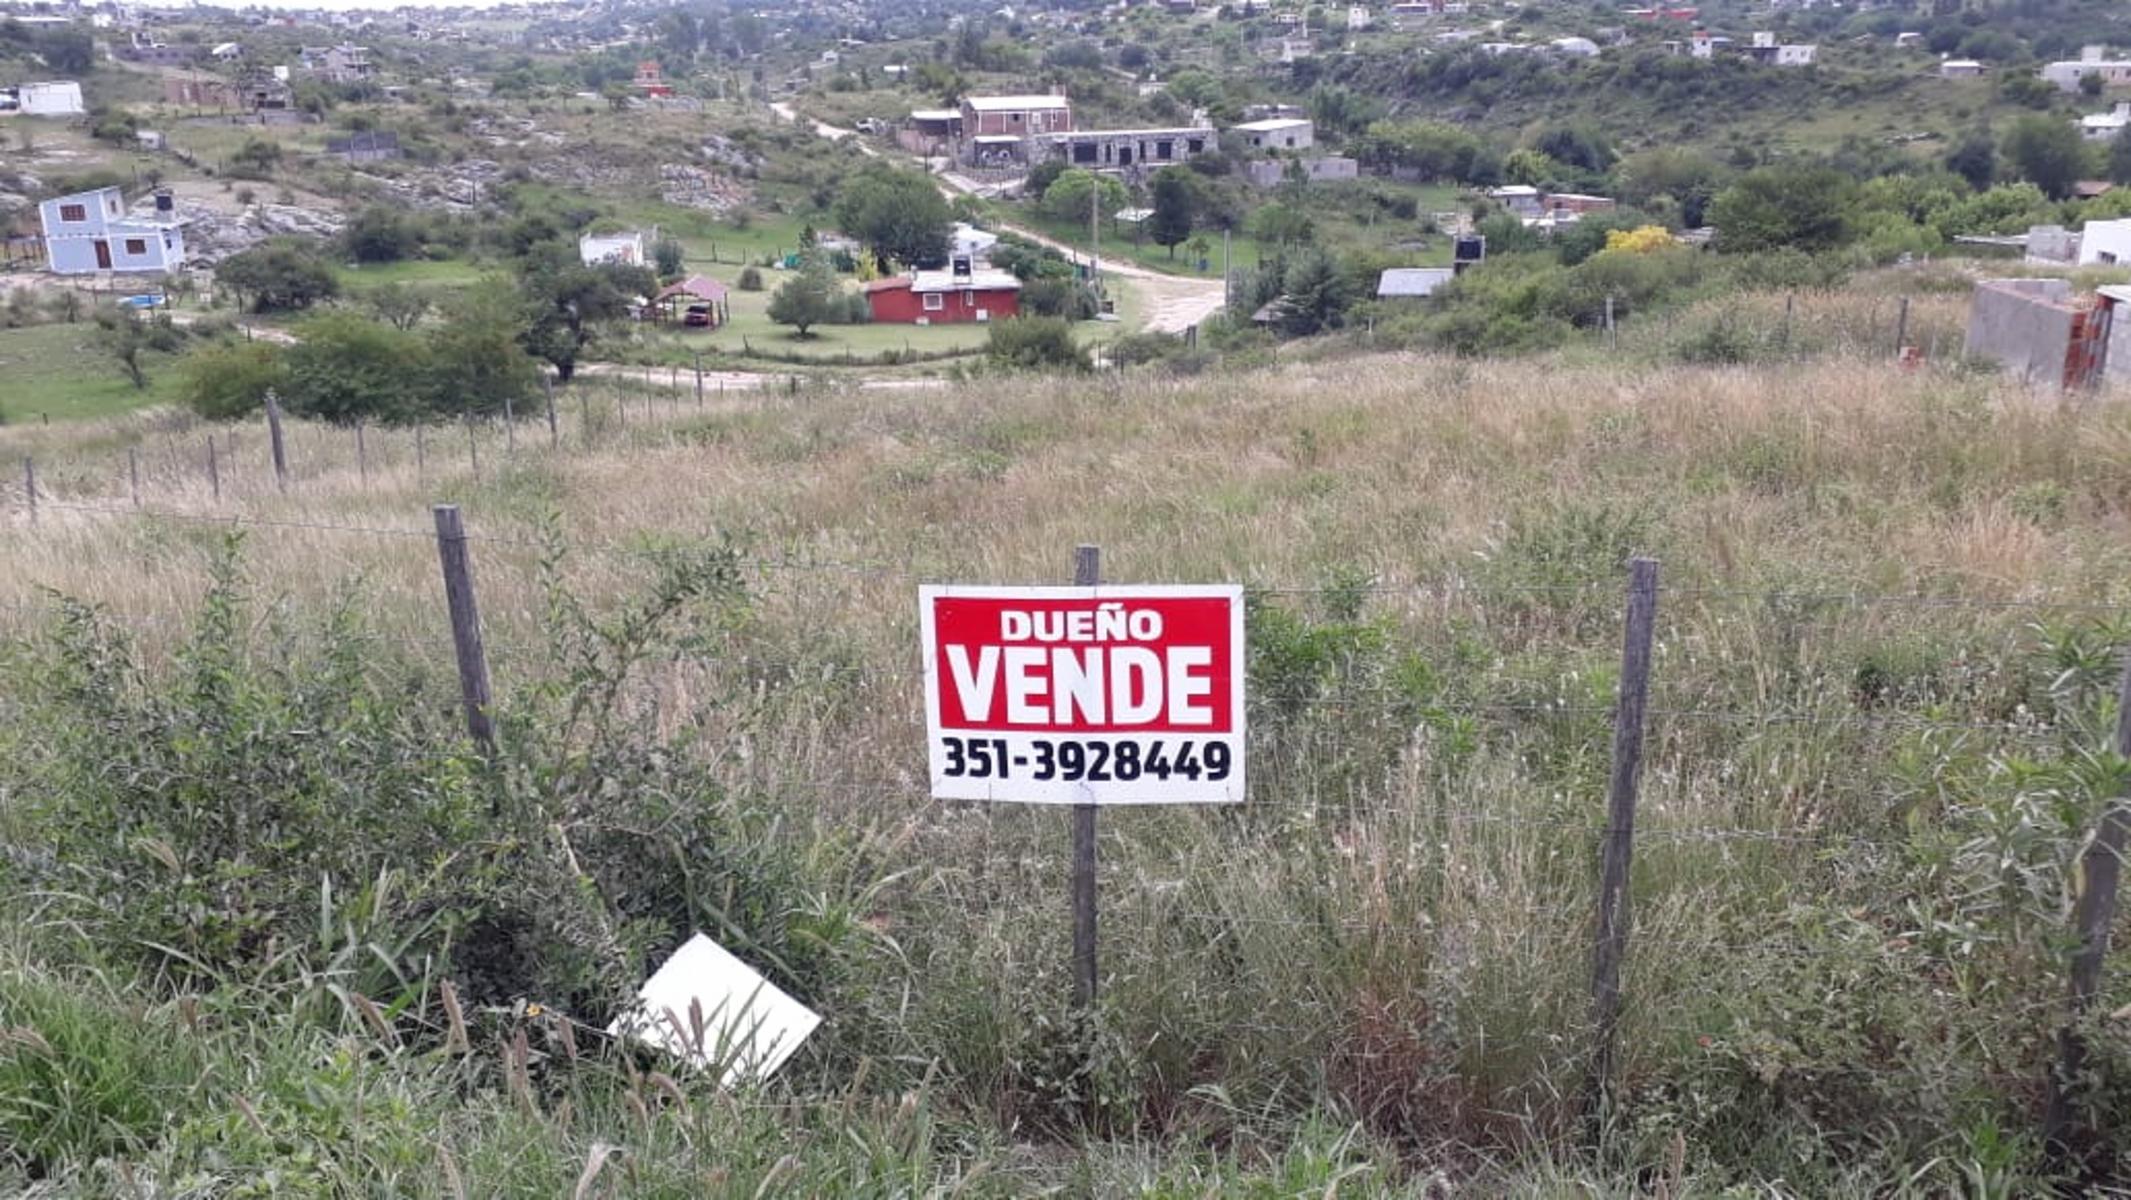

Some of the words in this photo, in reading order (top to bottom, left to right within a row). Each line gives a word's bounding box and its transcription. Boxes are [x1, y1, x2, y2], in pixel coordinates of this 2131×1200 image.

[1000, 602, 1163, 642] DUEÑO
[945, 644, 1213, 725] VENDE
[942, 737, 1231, 781] 351-3928449
